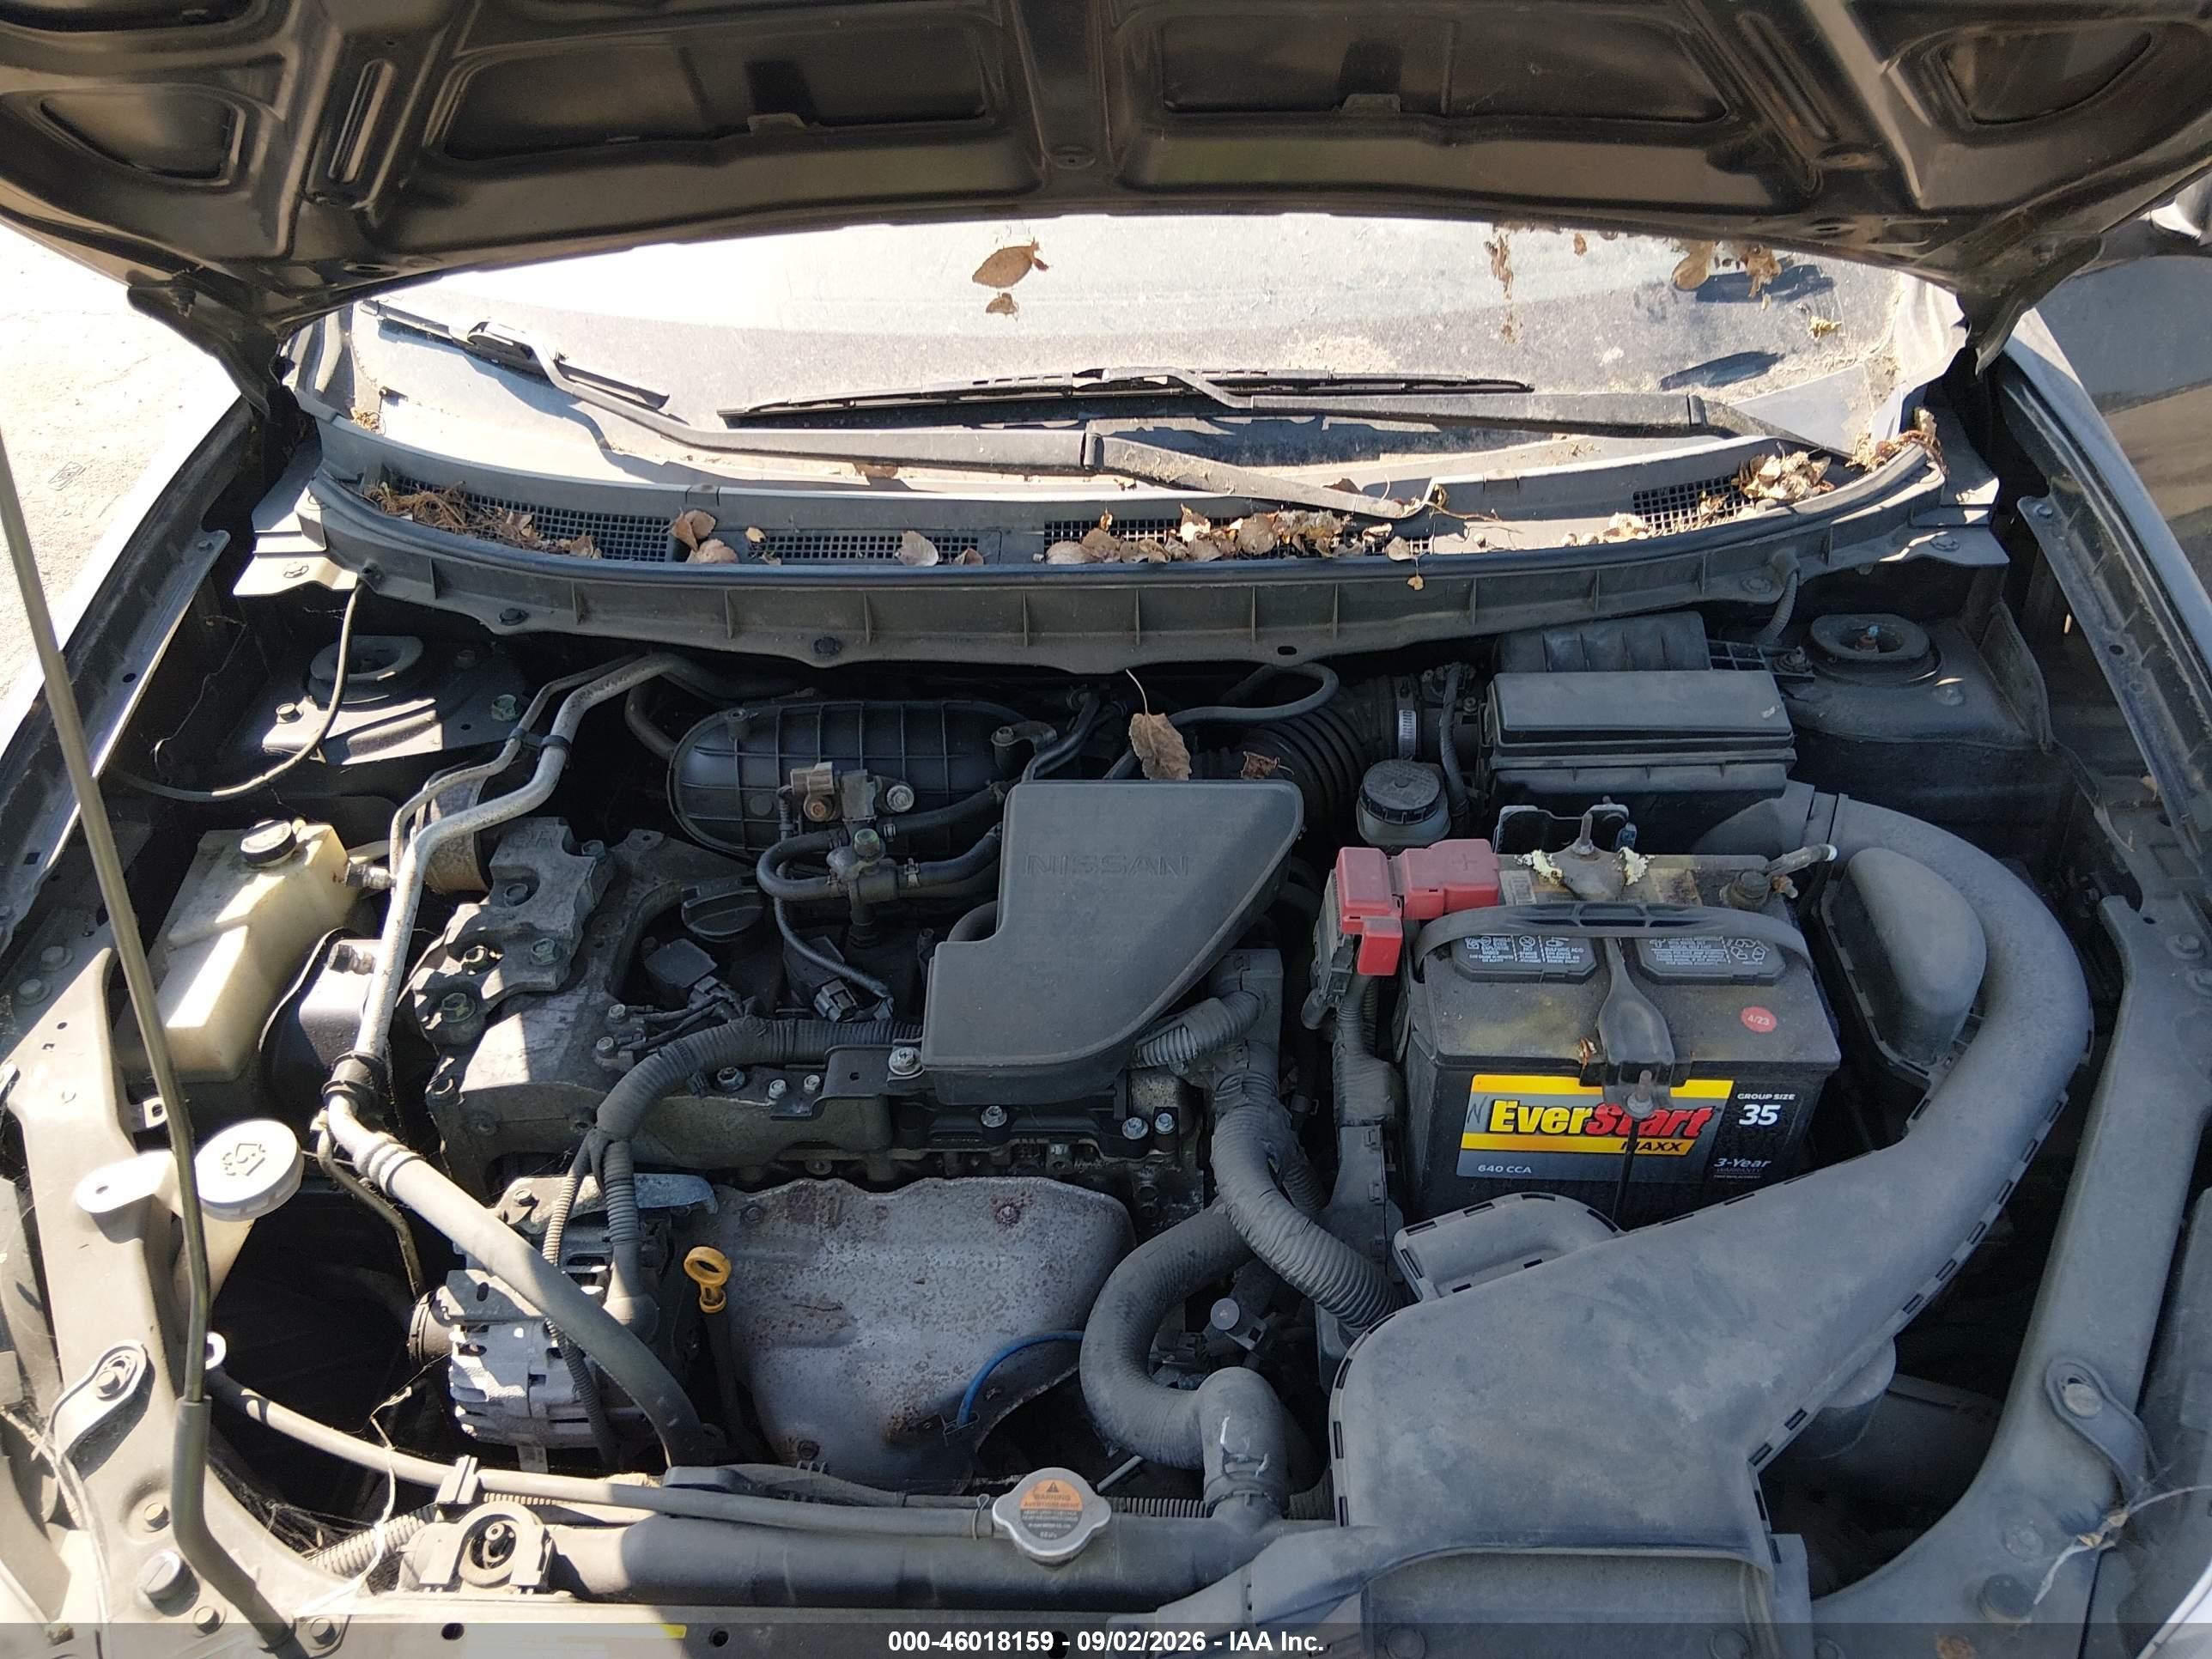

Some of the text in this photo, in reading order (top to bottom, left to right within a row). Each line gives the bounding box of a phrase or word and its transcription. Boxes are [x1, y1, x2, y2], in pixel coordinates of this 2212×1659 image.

[1024, 855, 1189, 877] NISSAN
[1747, 1015, 1770, 1026] 4/23
[1738, 1104, 1782, 1126] 35
[1477, 1164, 1504, 1173] 640
[1713, 1158, 1772, 1168] 3-Year
